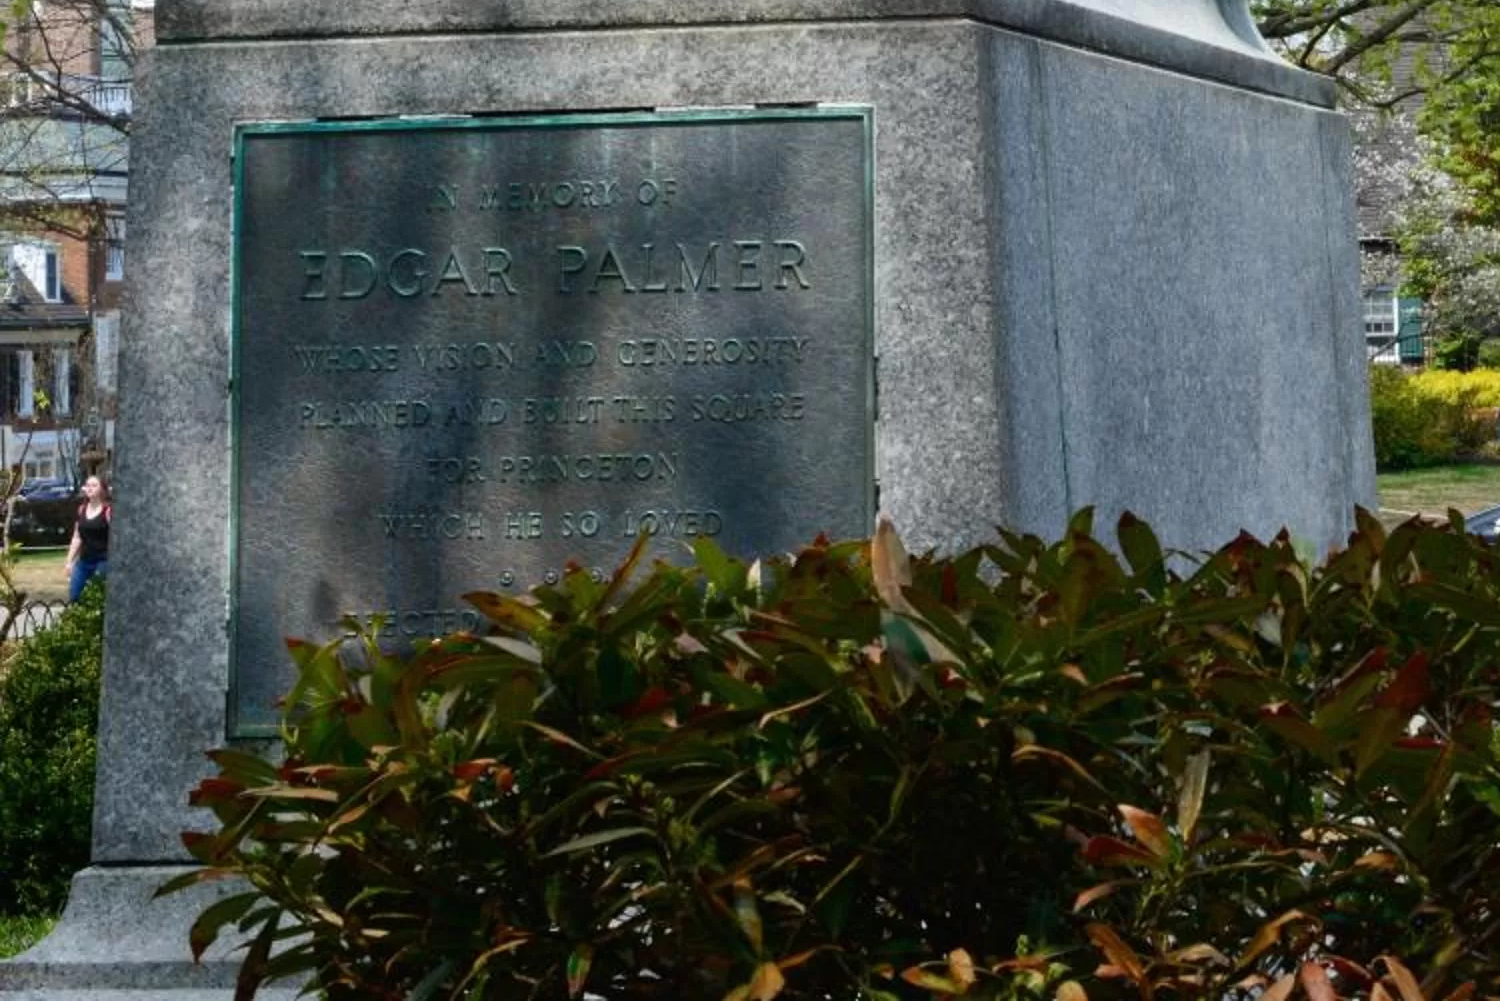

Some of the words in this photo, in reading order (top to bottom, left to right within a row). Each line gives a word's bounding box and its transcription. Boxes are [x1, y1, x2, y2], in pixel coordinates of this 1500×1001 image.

[479, 180, 622, 212] MEMORY
[638, 178, 679, 207] OF
[298, 247, 517, 301] EDGAR
[556, 239, 812, 295] PALMER
[295, 345, 399, 375] WHOSE
[414, 342, 515, 372] VISION
[533, 342, 599, 369] AND
[616, 337, 810, 367] GENEROSITY
[299, 399, 432, 430] PLANNED
[443, 397, 509, 427] AND
[522, 396, 604, 425] BUILT
[612, 394, 676, 424] THIS
[690, 393, 806, 423] SQUARE
[426, 456, 486, 485] FOR
[500, 452, 679, 483] PRINCETON
[377, 510, 486, 541] WHICH
[504, 509, 545, 540] HE
[560, 509, 601, 538] SO
[621, 508, 724, 537] LOVED
